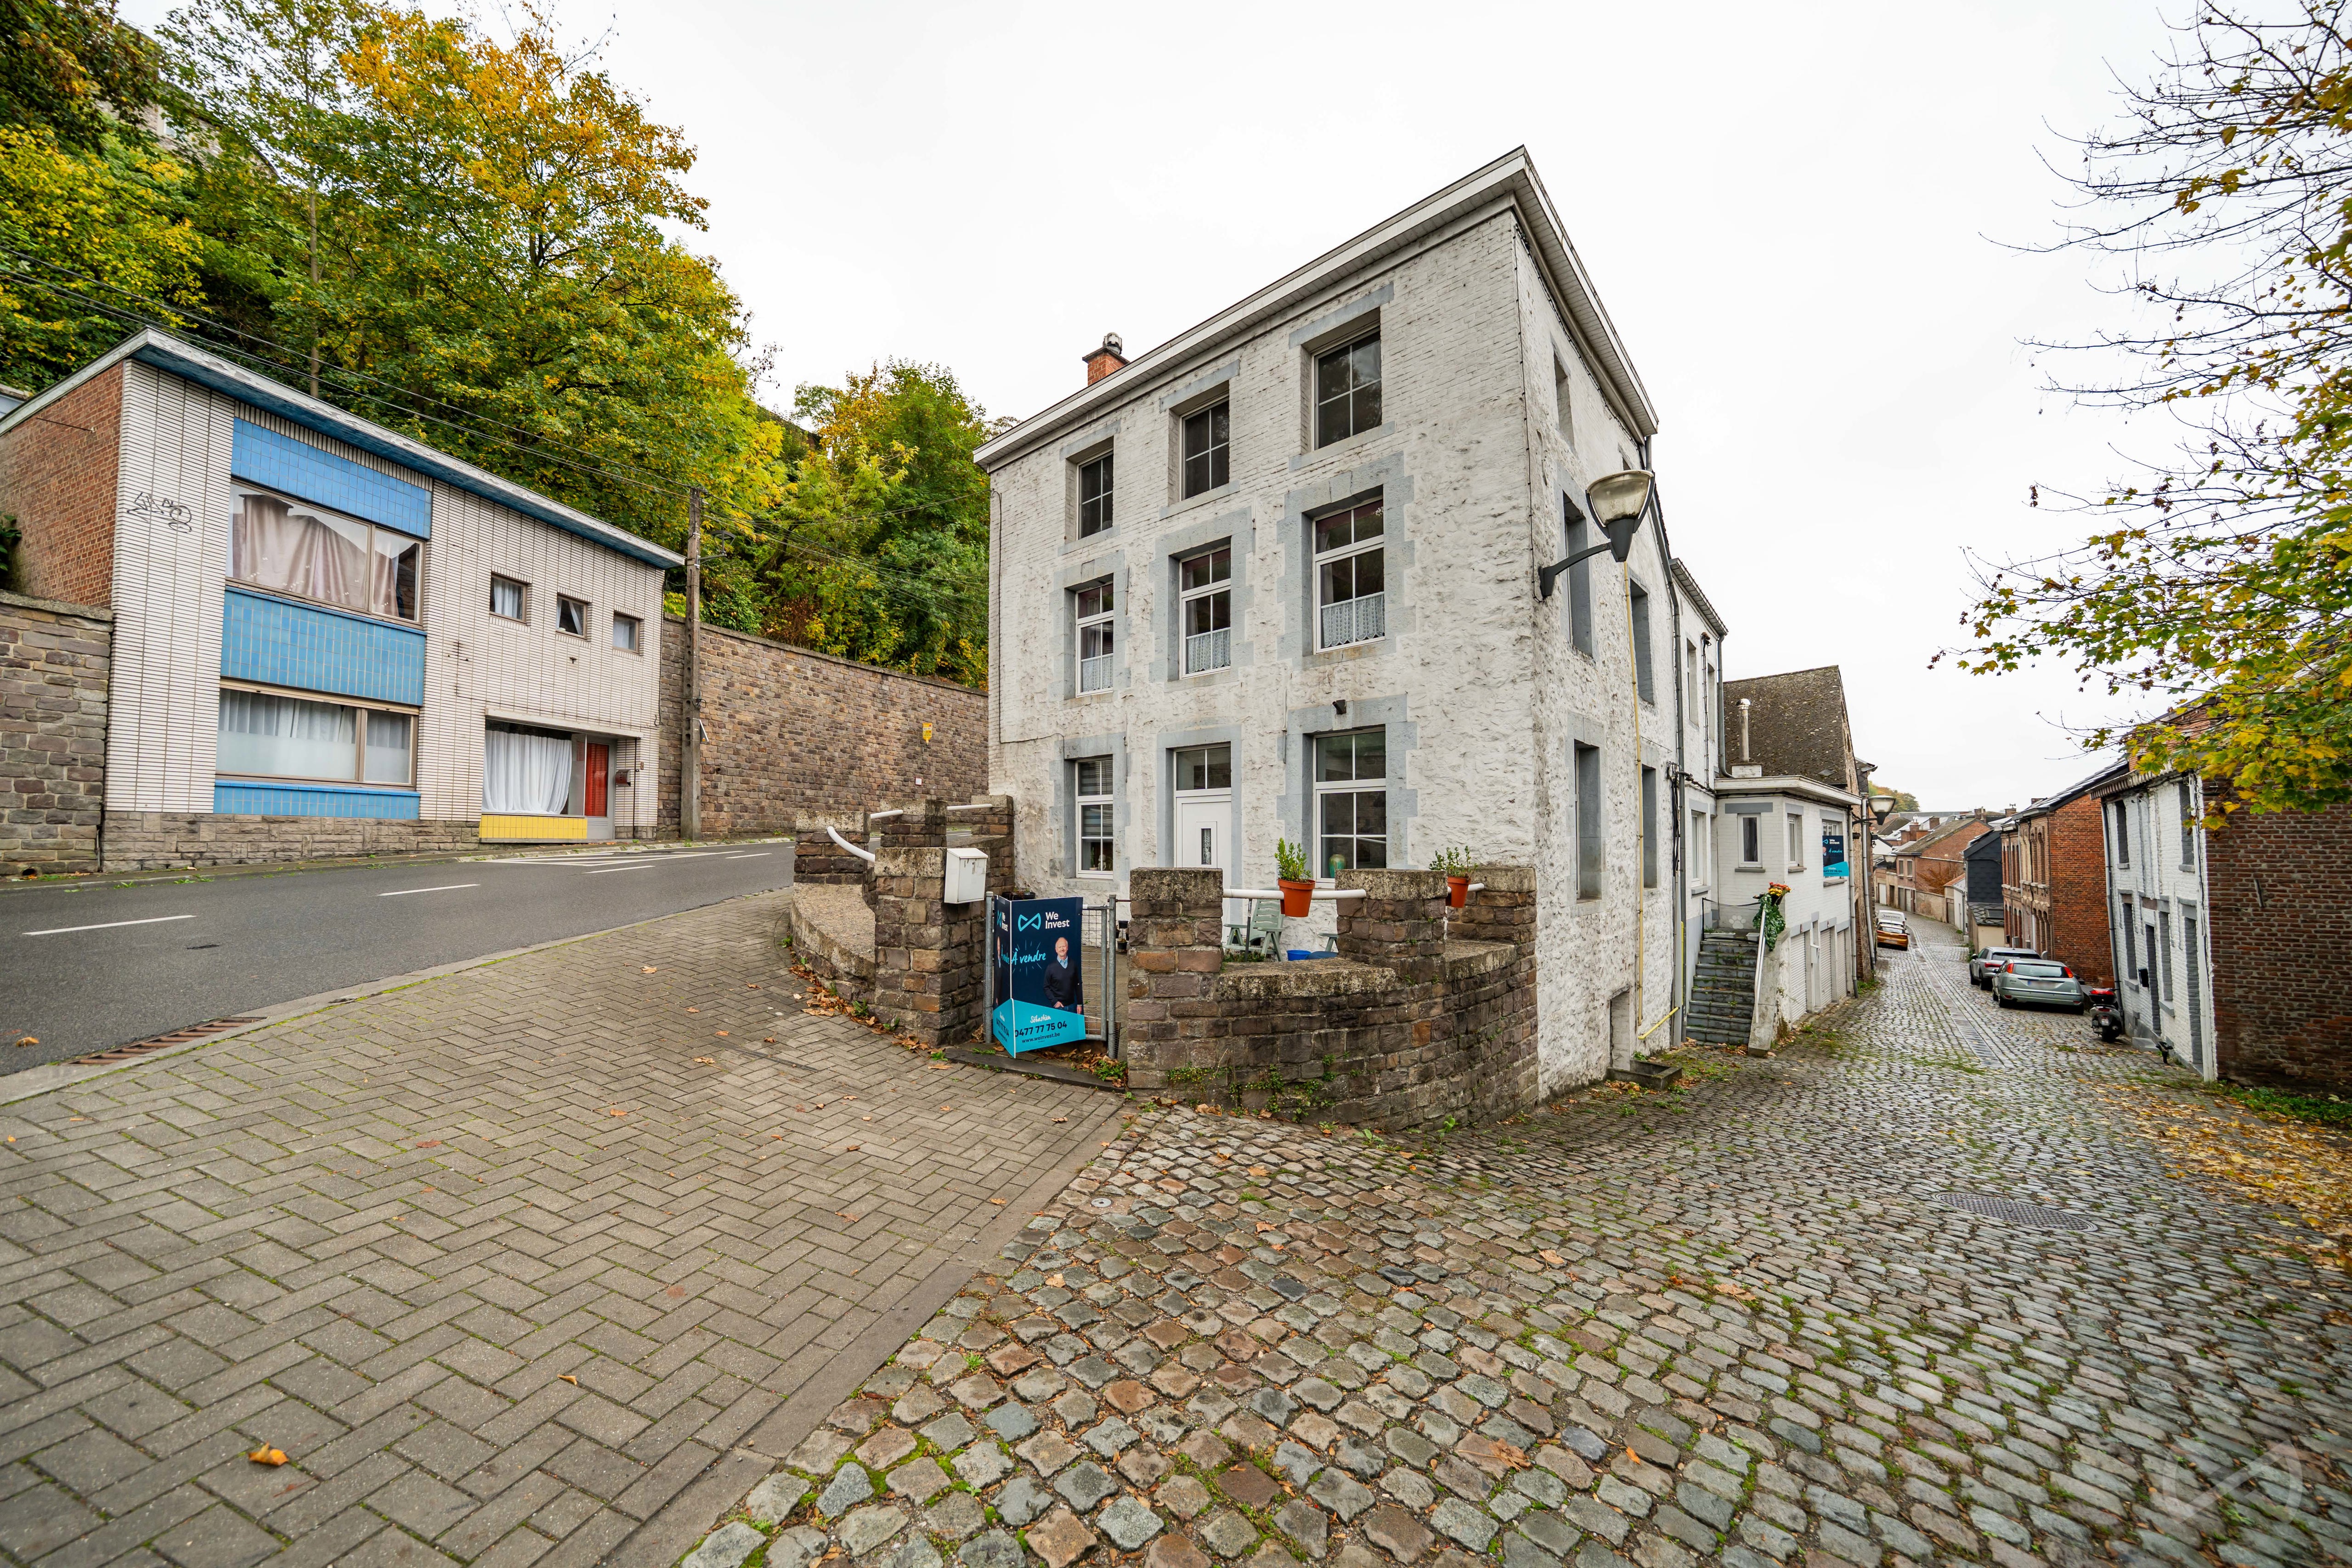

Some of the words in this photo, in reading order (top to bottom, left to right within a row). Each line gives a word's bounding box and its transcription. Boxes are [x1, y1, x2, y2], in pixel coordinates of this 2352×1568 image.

[1046, 911, 1058, 920] We
[1046, 919, 1070, 929] Invest
[1011, 948, 1018, 965] À
[1020, 950, 1046, 963] vendre
[1030, 1014, 1052, 1023] Sébastien
[1015, 1028, 1033, 1037] 0477
[1035, 1025, 1044, 1033] 77
[1057, 1021, 1067, 1029] 04
[1022, 1032, 1060, 1043] www.weinvest.be
